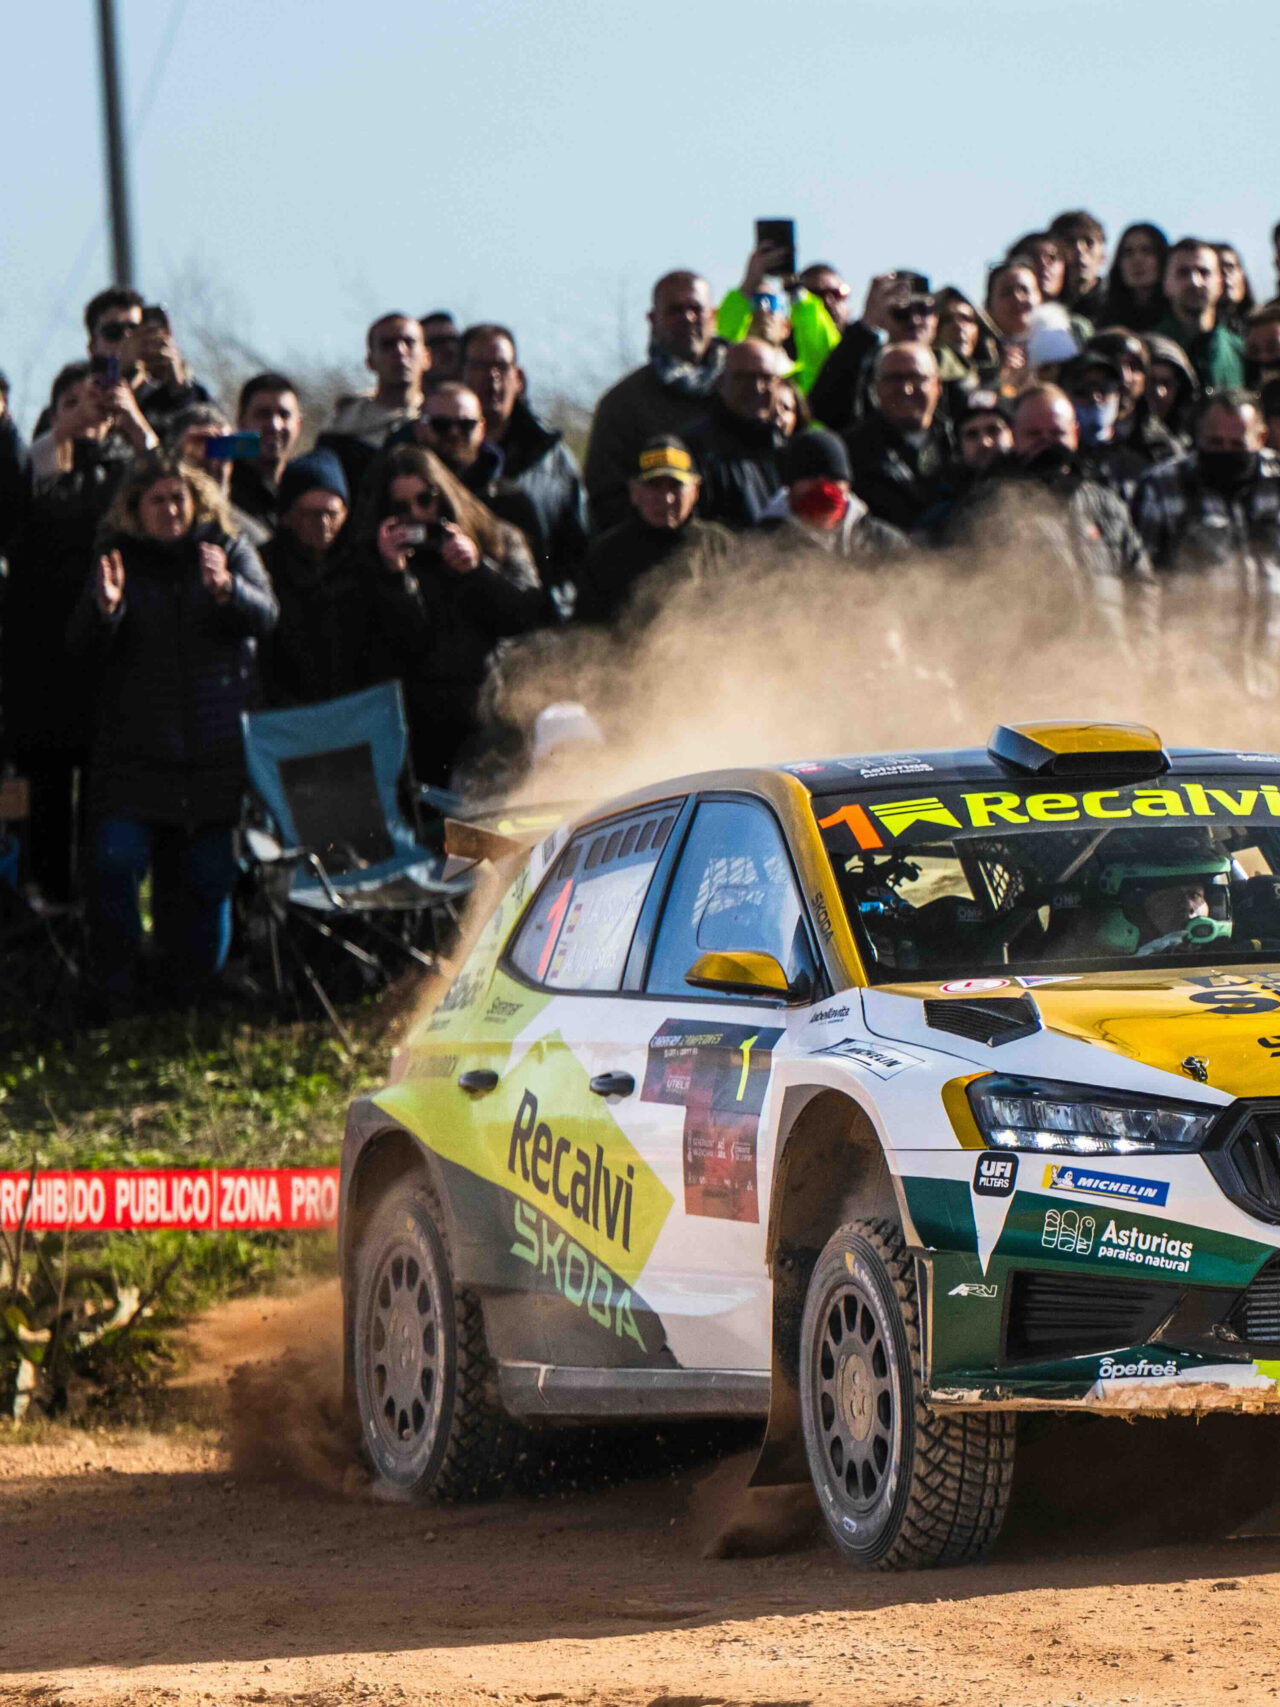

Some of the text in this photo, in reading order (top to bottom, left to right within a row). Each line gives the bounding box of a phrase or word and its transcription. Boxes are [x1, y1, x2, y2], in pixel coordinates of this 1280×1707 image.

[818, 804, 883, 849] 1
[736, 1035, 758, 1101] 1
[508, 1088, 634, 1253] Recalvi
[979, 1177, 1010, 1189] FILTERS
[980, 1160, 1012, 1178] UFI
[1077, 1177, 1158, 1198] MICHELIN
[115, 1177, 210, 1223] PUBLICO
[220, 1176, 281, 1222] ZONA
[1098, 1246, 1190, 1272] paraíso natural
[1101, 1219, 1193, 1259] Asturias
